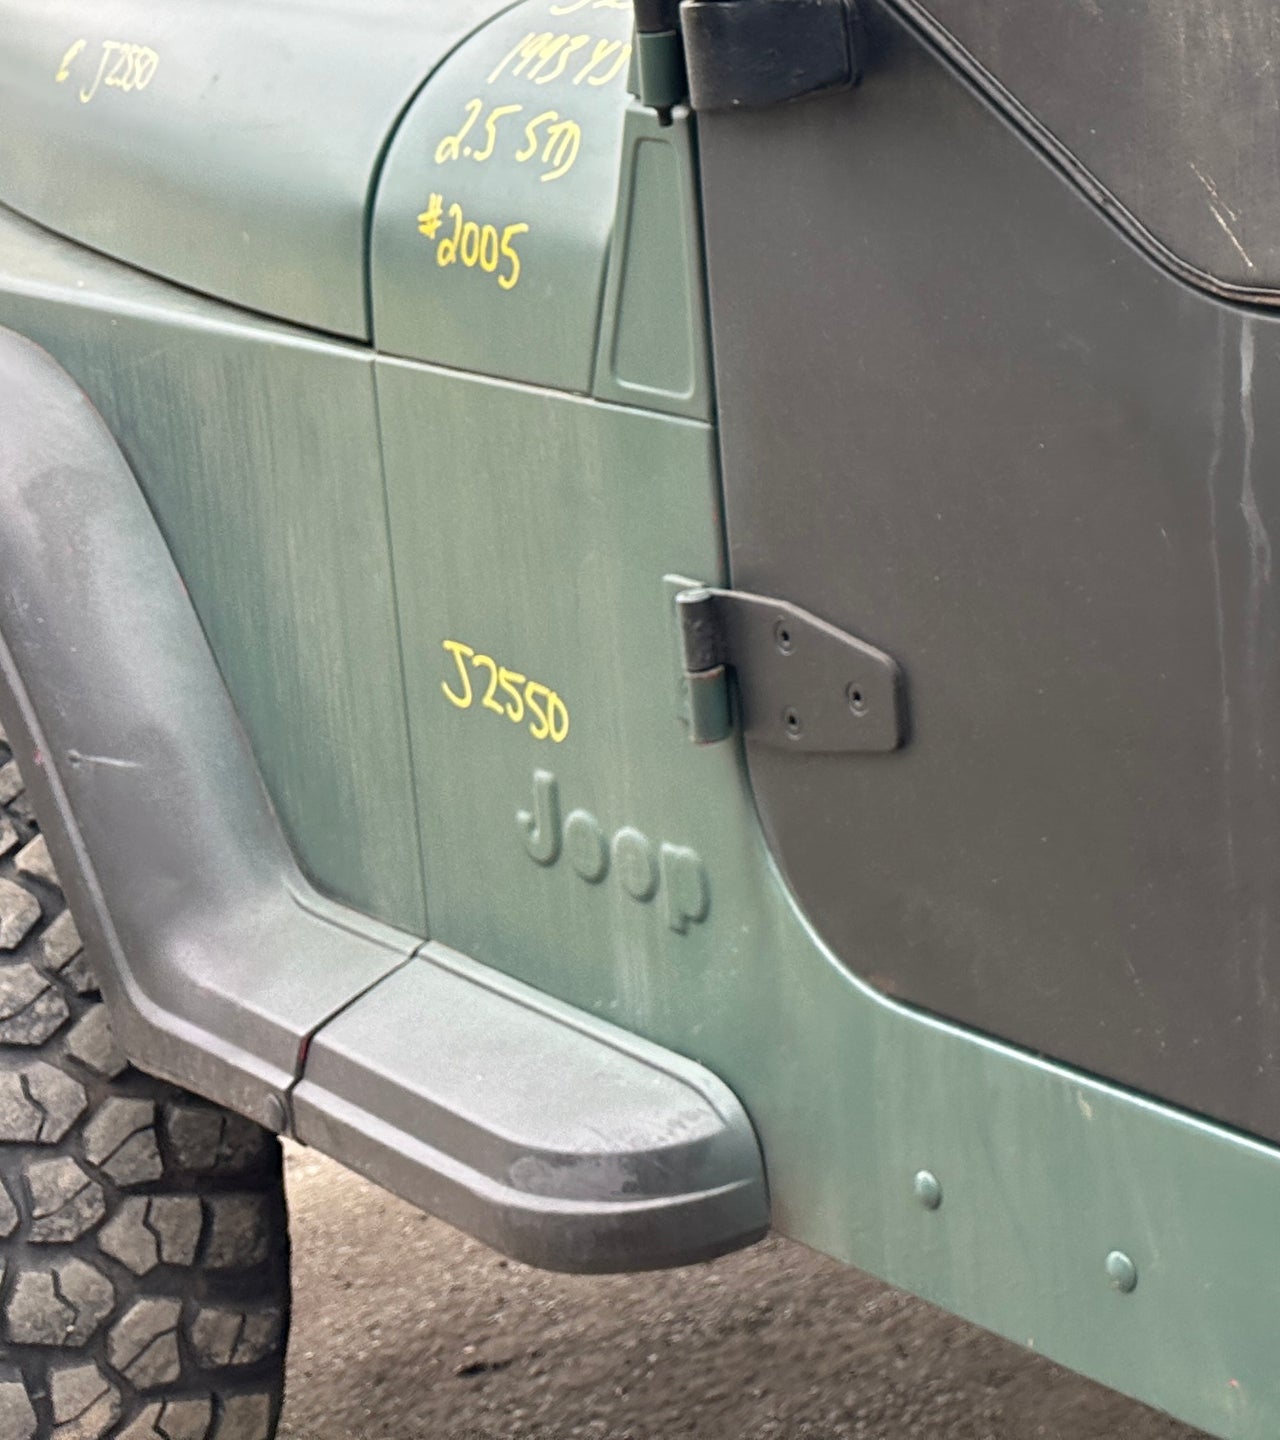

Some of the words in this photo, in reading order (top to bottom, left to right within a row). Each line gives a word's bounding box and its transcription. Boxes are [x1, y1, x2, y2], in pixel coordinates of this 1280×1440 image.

[486, 31, 590, 85] 1993
[434, 97, 524, 165] 2.5
[416, 191, 530, 291] #2005
[440, 639, 569, 742] J2550
